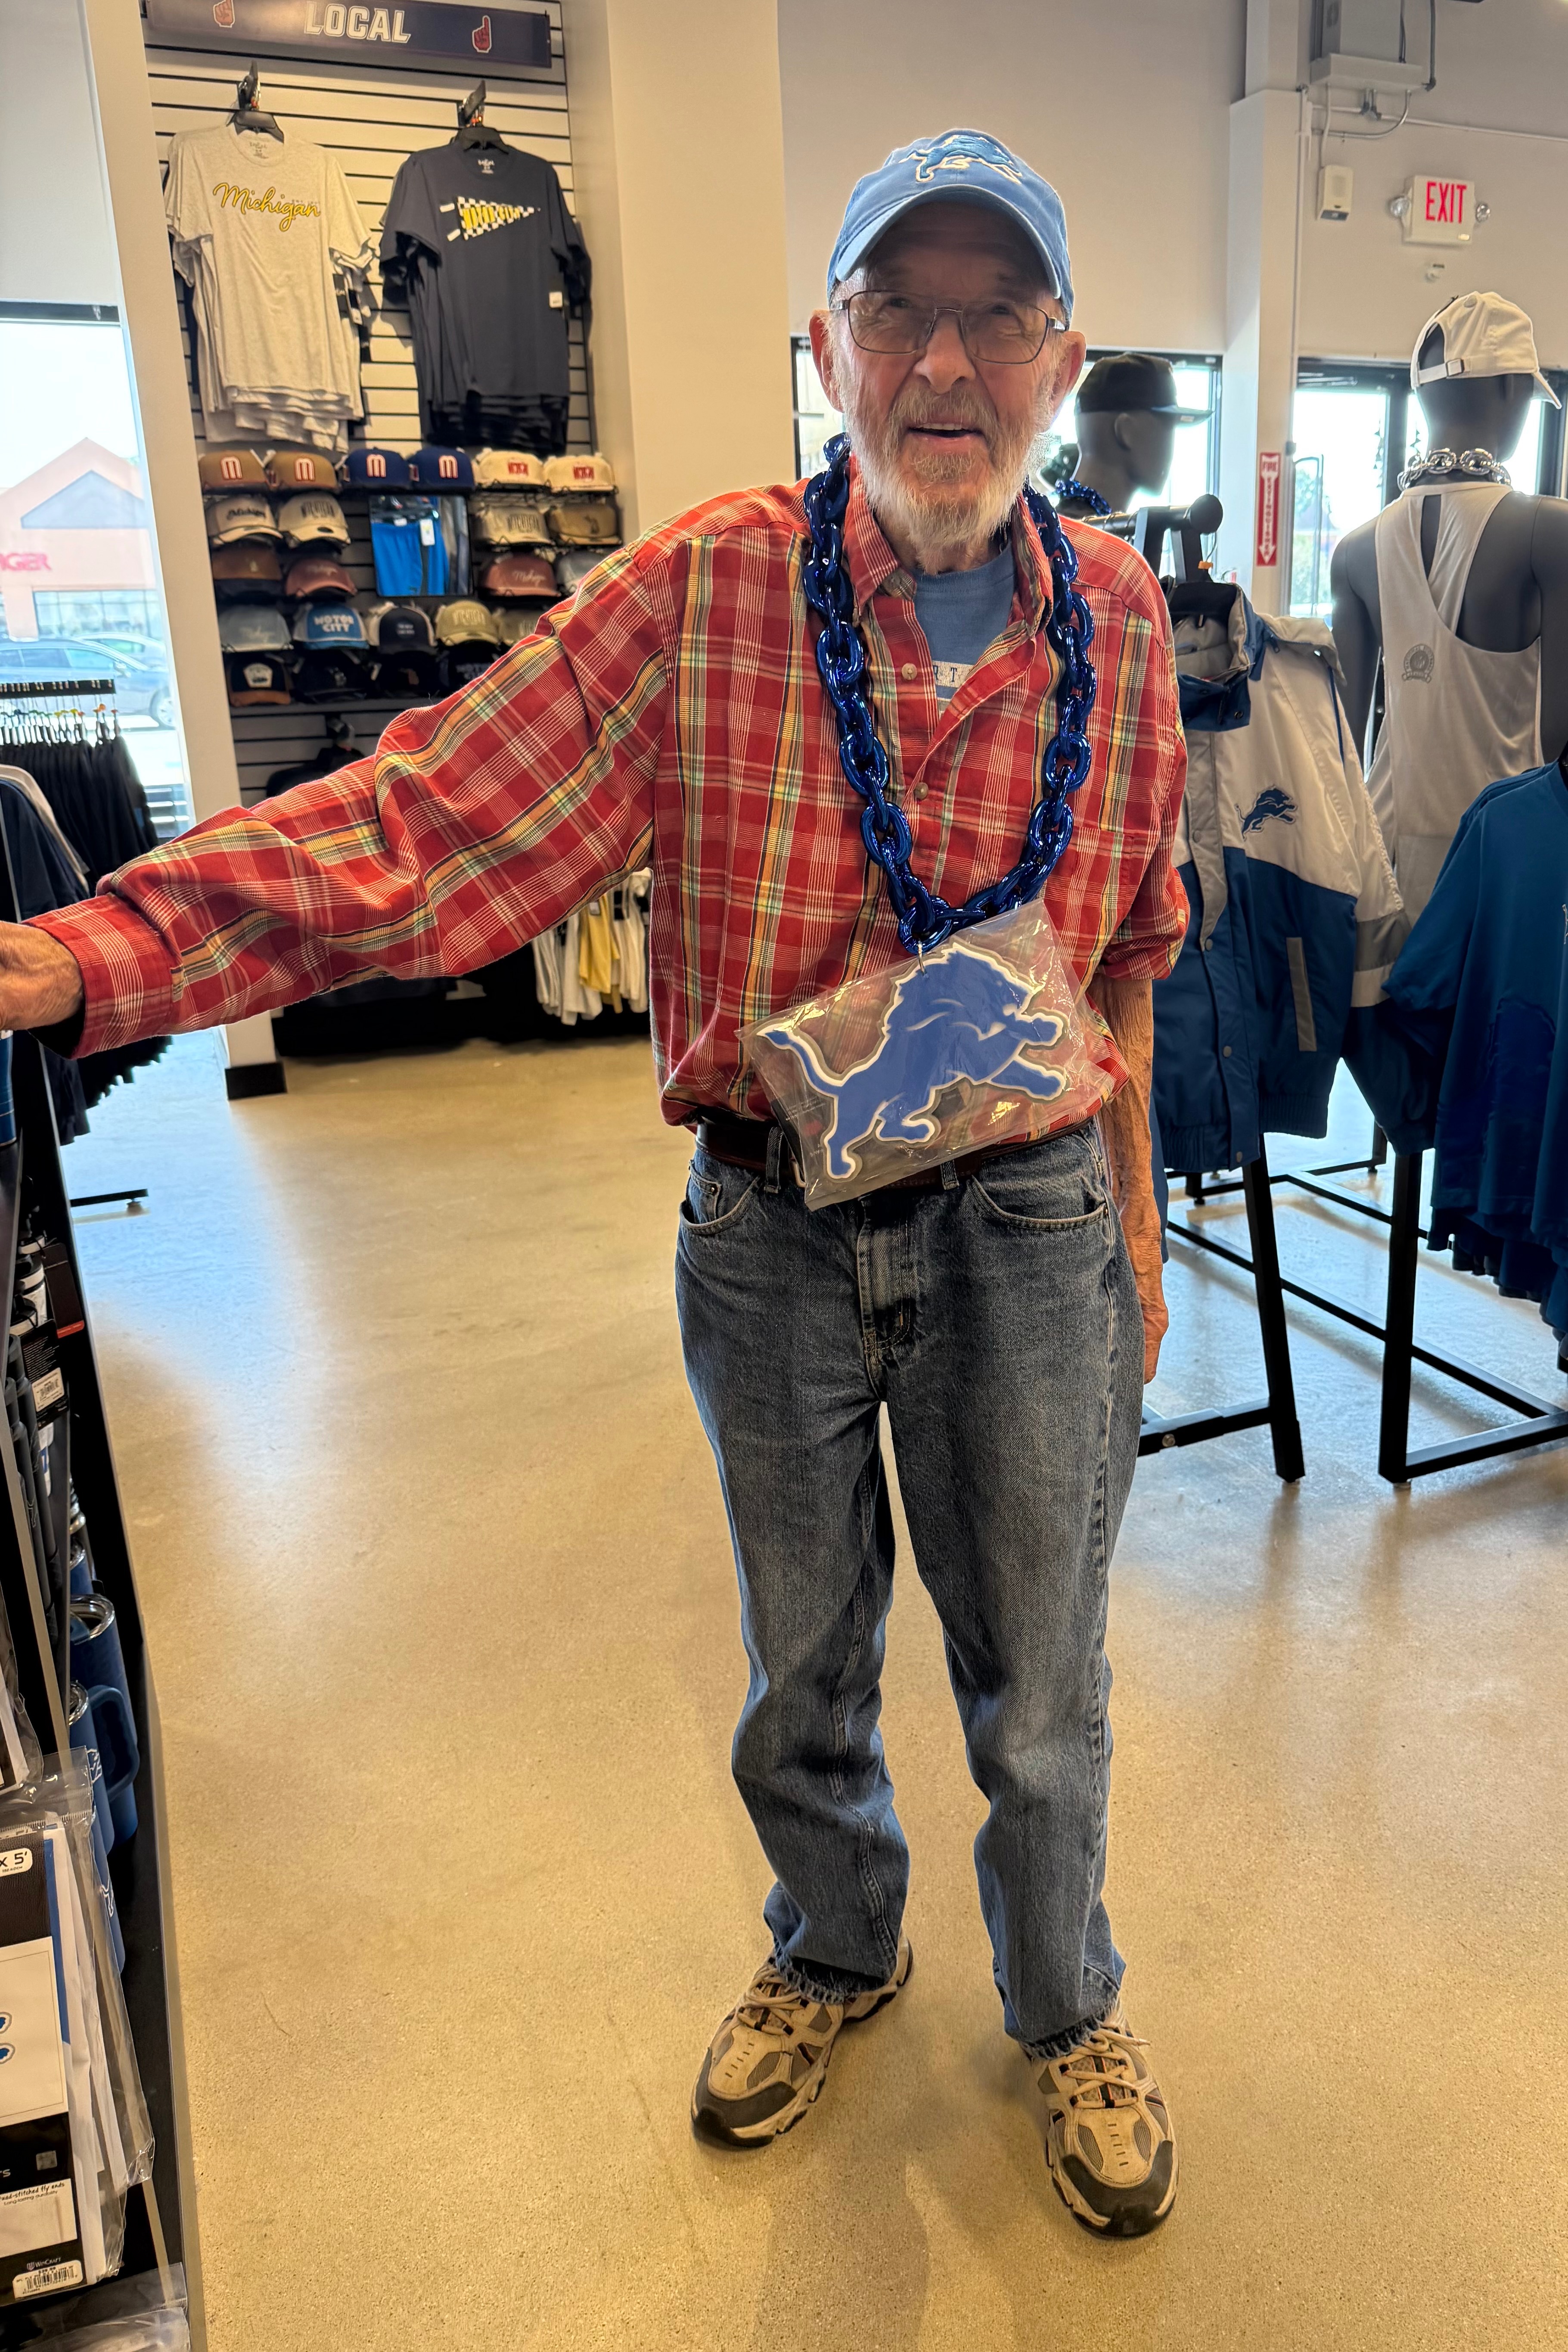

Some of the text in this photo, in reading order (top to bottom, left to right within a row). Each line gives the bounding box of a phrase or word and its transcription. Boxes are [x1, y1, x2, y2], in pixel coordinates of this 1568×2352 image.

[304, 1, 411, 43] LOCAL
[213, 182, 321, 232] Michigan
[1425, 181, 1467, 224] EXIT
[314, 614, 354, 625] MOTOR
[322, 624, 349, 633] CITY
[0, 2188, 39, 2200] uad-stitched
